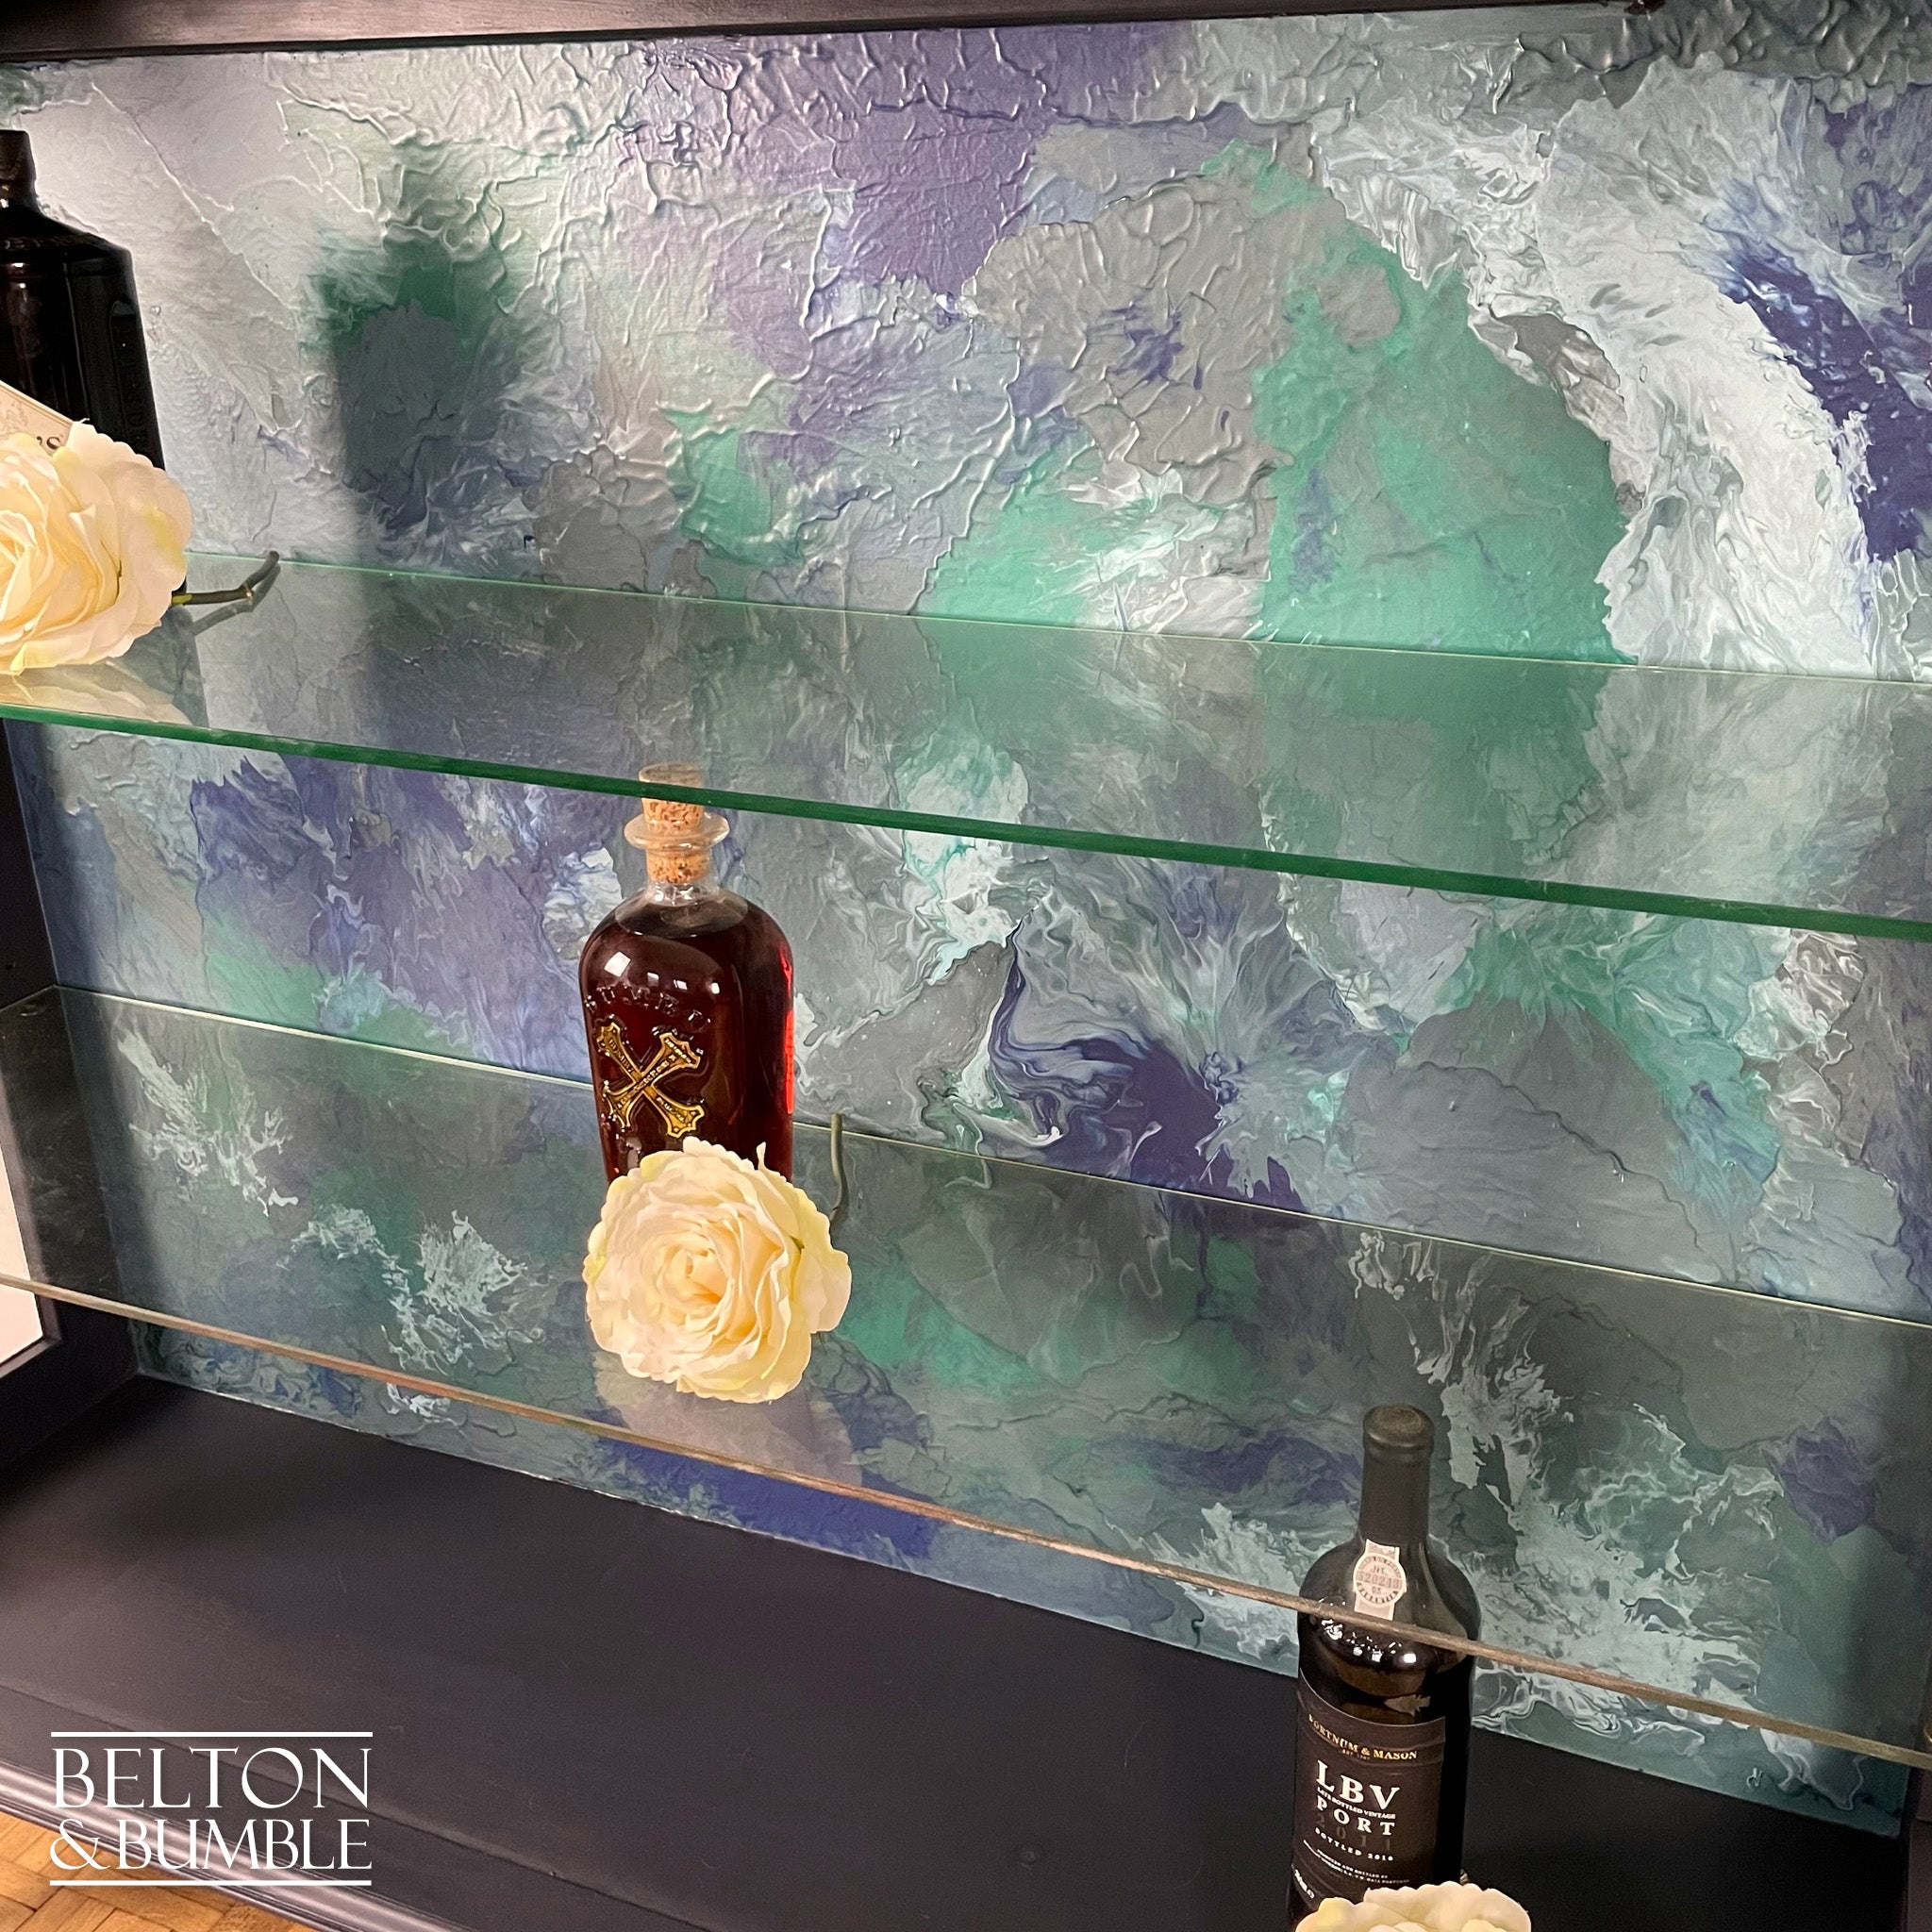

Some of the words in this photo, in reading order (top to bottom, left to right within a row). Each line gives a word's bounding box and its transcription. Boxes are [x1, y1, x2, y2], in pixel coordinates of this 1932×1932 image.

[1308, 1713, 1358, 1753] FORTNUM
[1360, 1747, 1371, 1756] &
[1374, 1749, 1417, 1760] MASON
[1316, 1759, 1400, 1810] LBV
[1317, 1786, 1332, 1801] LATE
[1331, 1797, 1363, 1814] BOTTLED
[1316, 1794, 1395, 1836] PORT
[1314, 1826, 1362, 1856] BOTTLED
